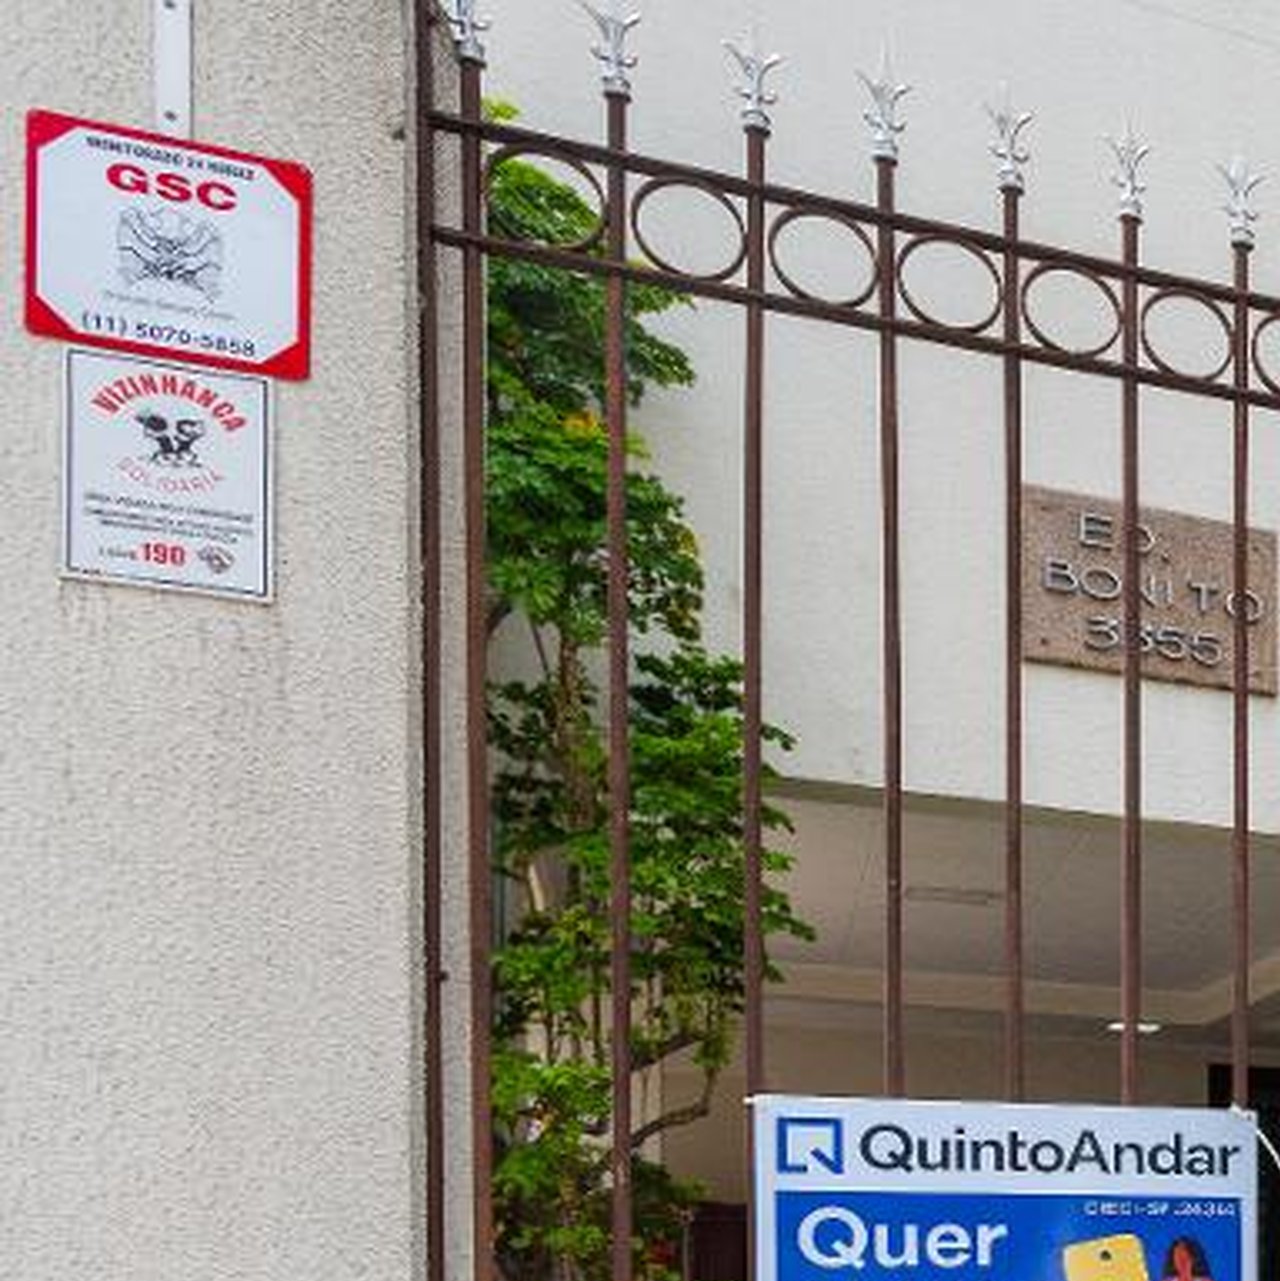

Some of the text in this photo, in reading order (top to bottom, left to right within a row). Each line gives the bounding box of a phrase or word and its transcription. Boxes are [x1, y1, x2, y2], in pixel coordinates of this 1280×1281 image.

[106, 163, 238, 211] GSC
[82, 311, 128, 336] (11)
[142, 542, 187, 567] 190
[859, 1123, 1240, 1176] QuintoAndar
[797, 1205, 1008, 1269] Quer
